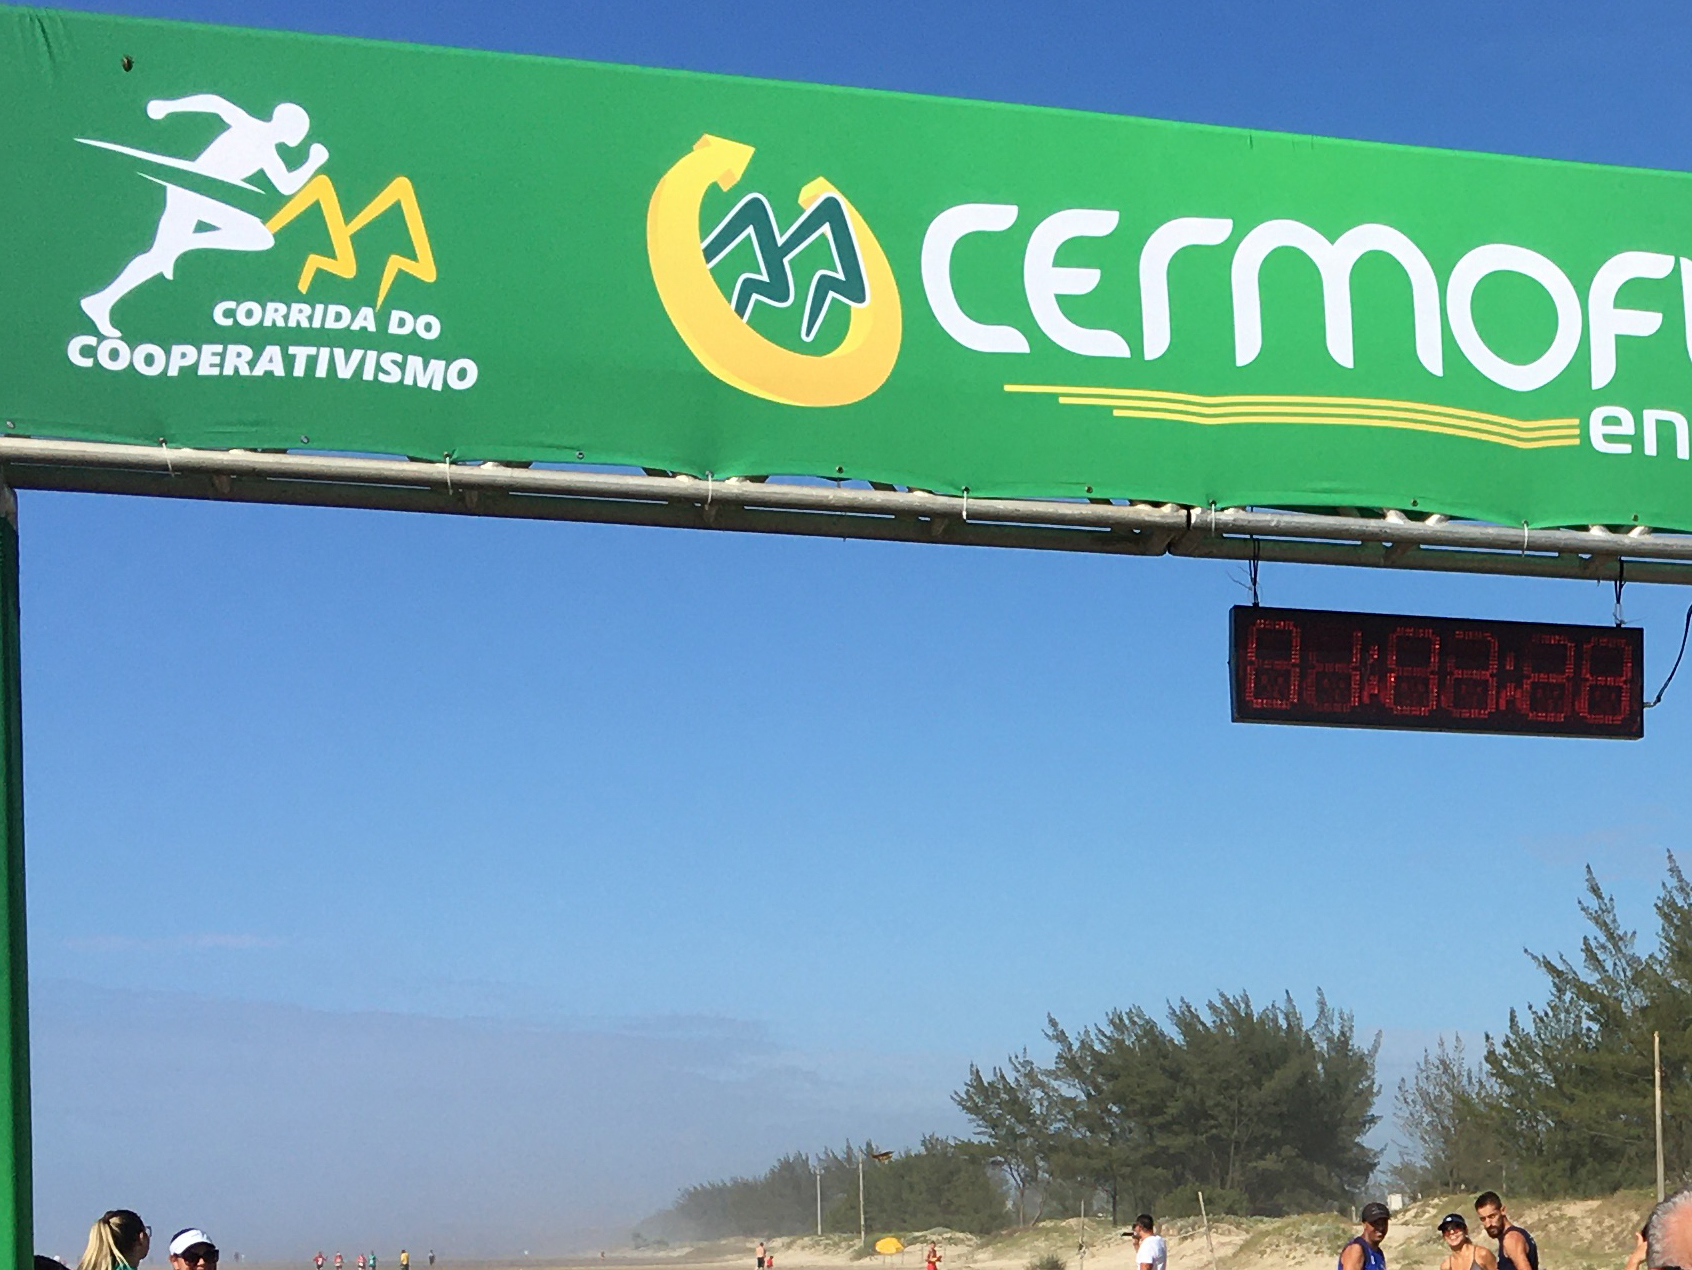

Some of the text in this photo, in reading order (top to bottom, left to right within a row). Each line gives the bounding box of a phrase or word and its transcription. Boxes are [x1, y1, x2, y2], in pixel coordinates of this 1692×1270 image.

[212, 300, 442, 340] CORRIDA DO
[66, 334, 479, 392] COOPERATIVISMO
